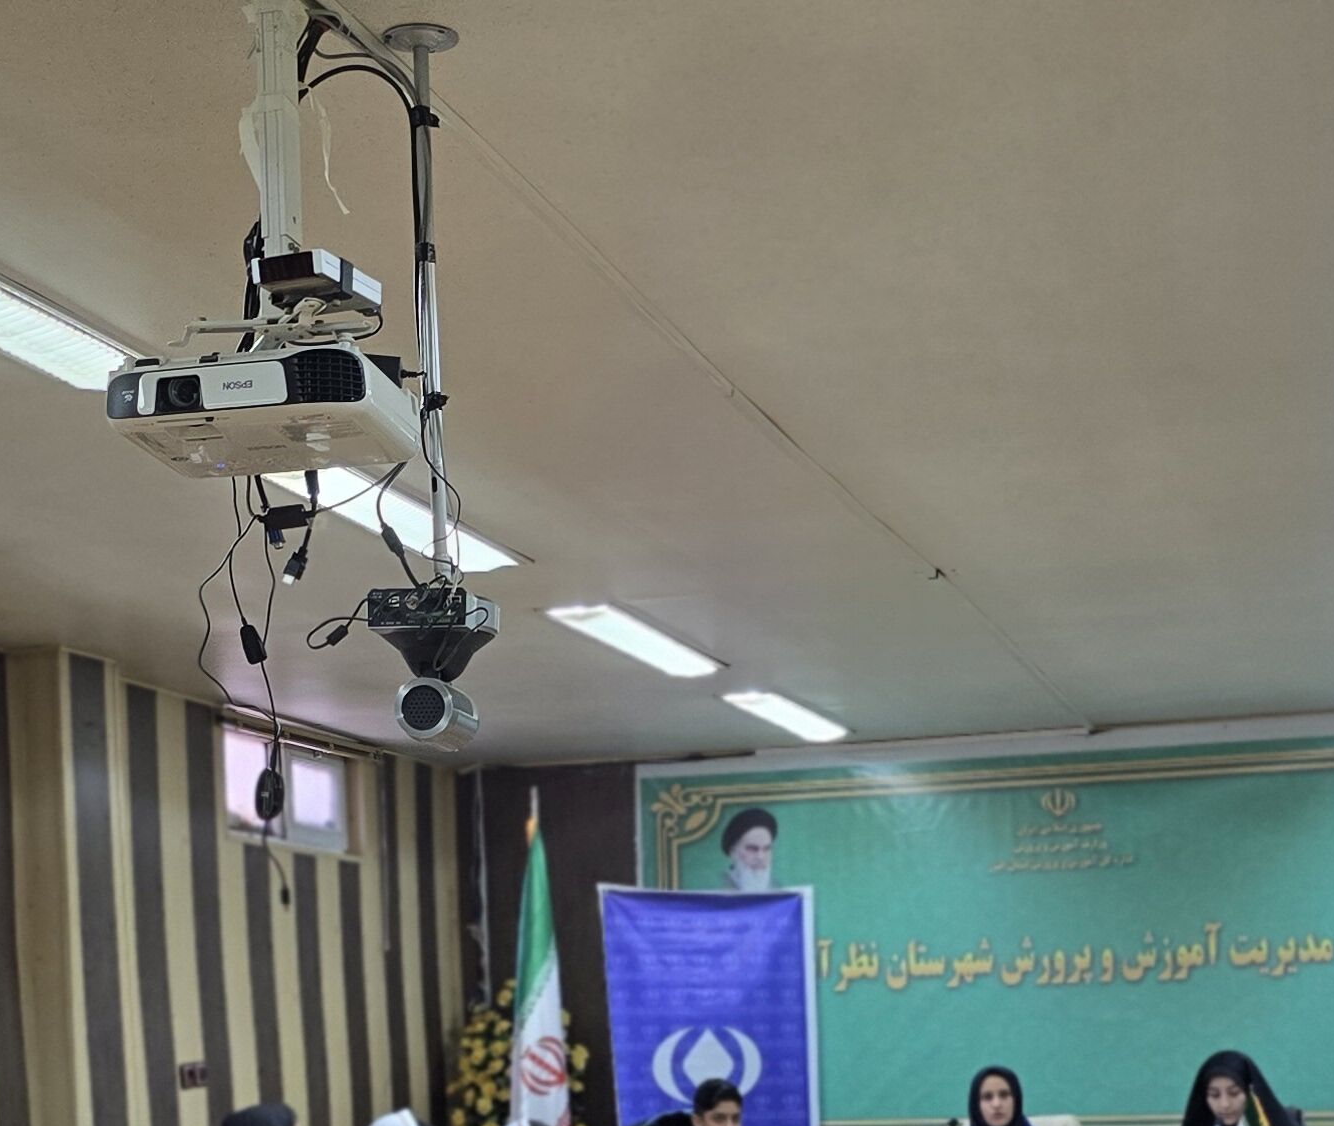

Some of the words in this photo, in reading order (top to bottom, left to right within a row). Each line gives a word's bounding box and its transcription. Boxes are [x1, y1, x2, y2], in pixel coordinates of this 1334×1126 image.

[221, 379, 253, 391] EPSON
[886, 937, 993, 989] شهرستان
[1001, 935, 1092, 986] پرورش
[1099, 947, 1114, 983] و
[1121, 922, 1221, 982] آموزش
[1229, 934, 1334, 977] مدیریت
